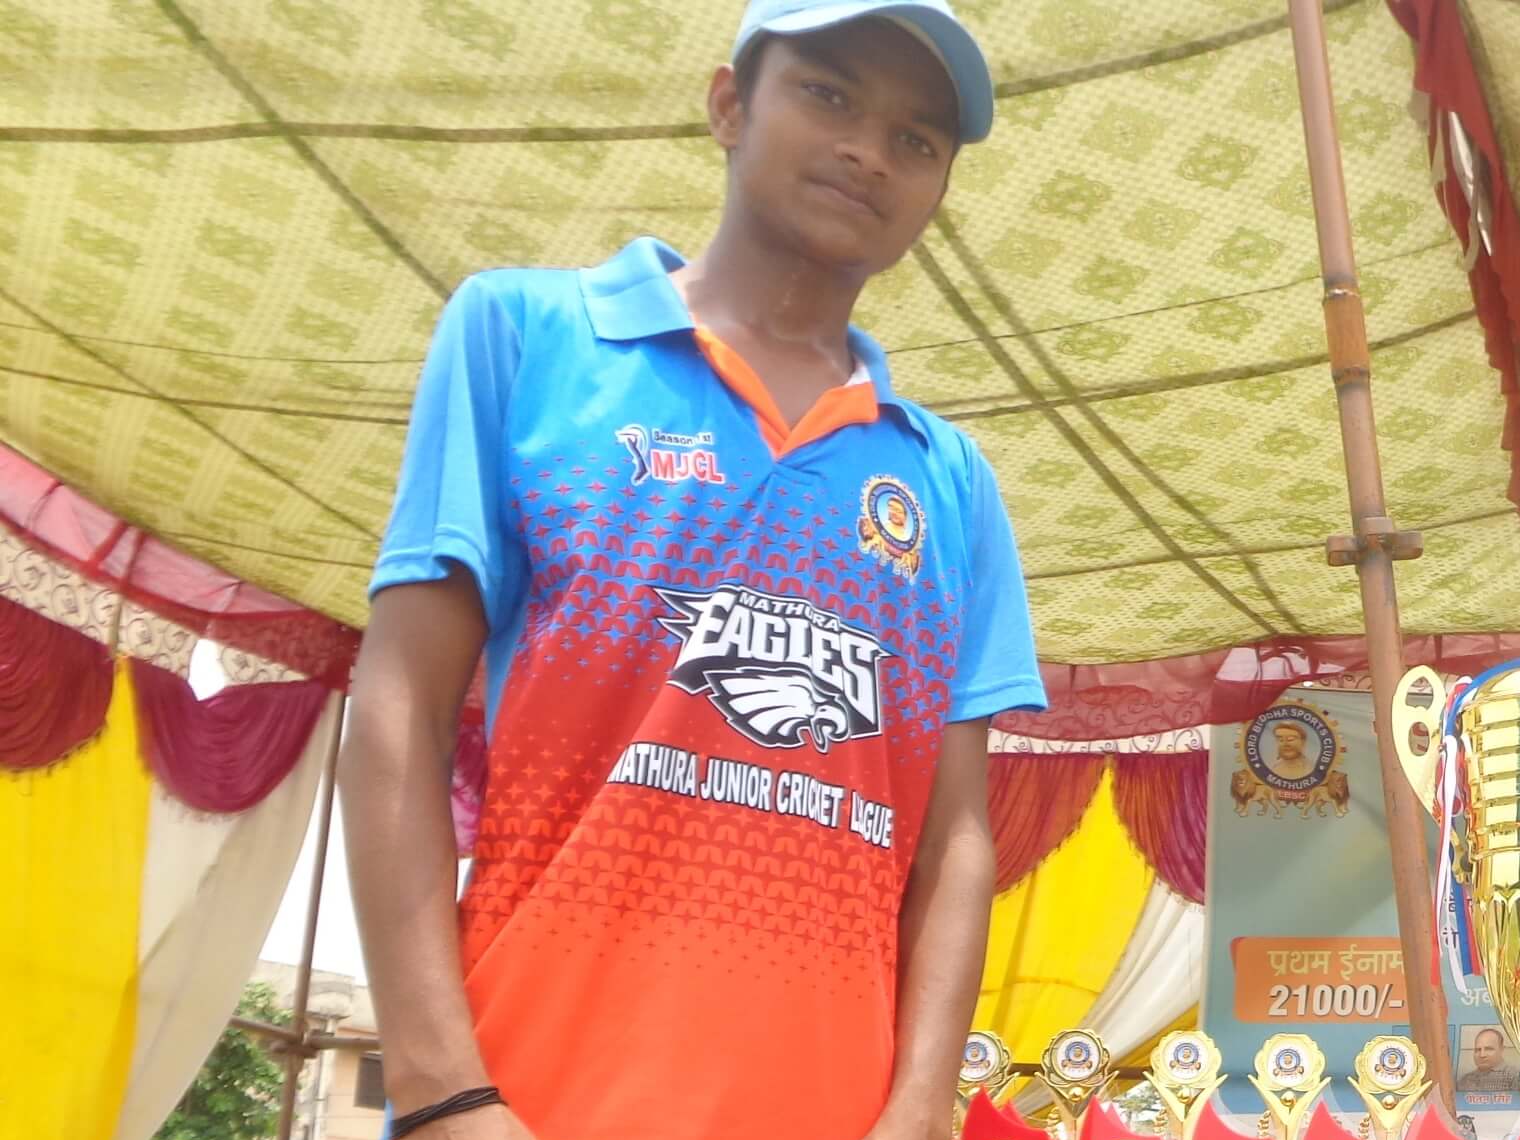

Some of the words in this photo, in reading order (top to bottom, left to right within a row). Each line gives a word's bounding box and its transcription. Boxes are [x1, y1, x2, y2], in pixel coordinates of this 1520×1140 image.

[651, 450, 723, 483] MJCL
[738, 590, 841, 633] MATHURA
[678, 590, 882, 727] EAGLES
[1247, 732, 1260, 763] LORD
[1290, 707, 1329, 737] SPORTS
[1319, 737, 1334, 764] CLUB
[700, 756, 773, 812] JUNIOR
[1266, 774, 1318, 791] MATHURA
[1267, 949, 1332, 978] प्रथम
[1268, 983, 1405, 1018] 21000/-
